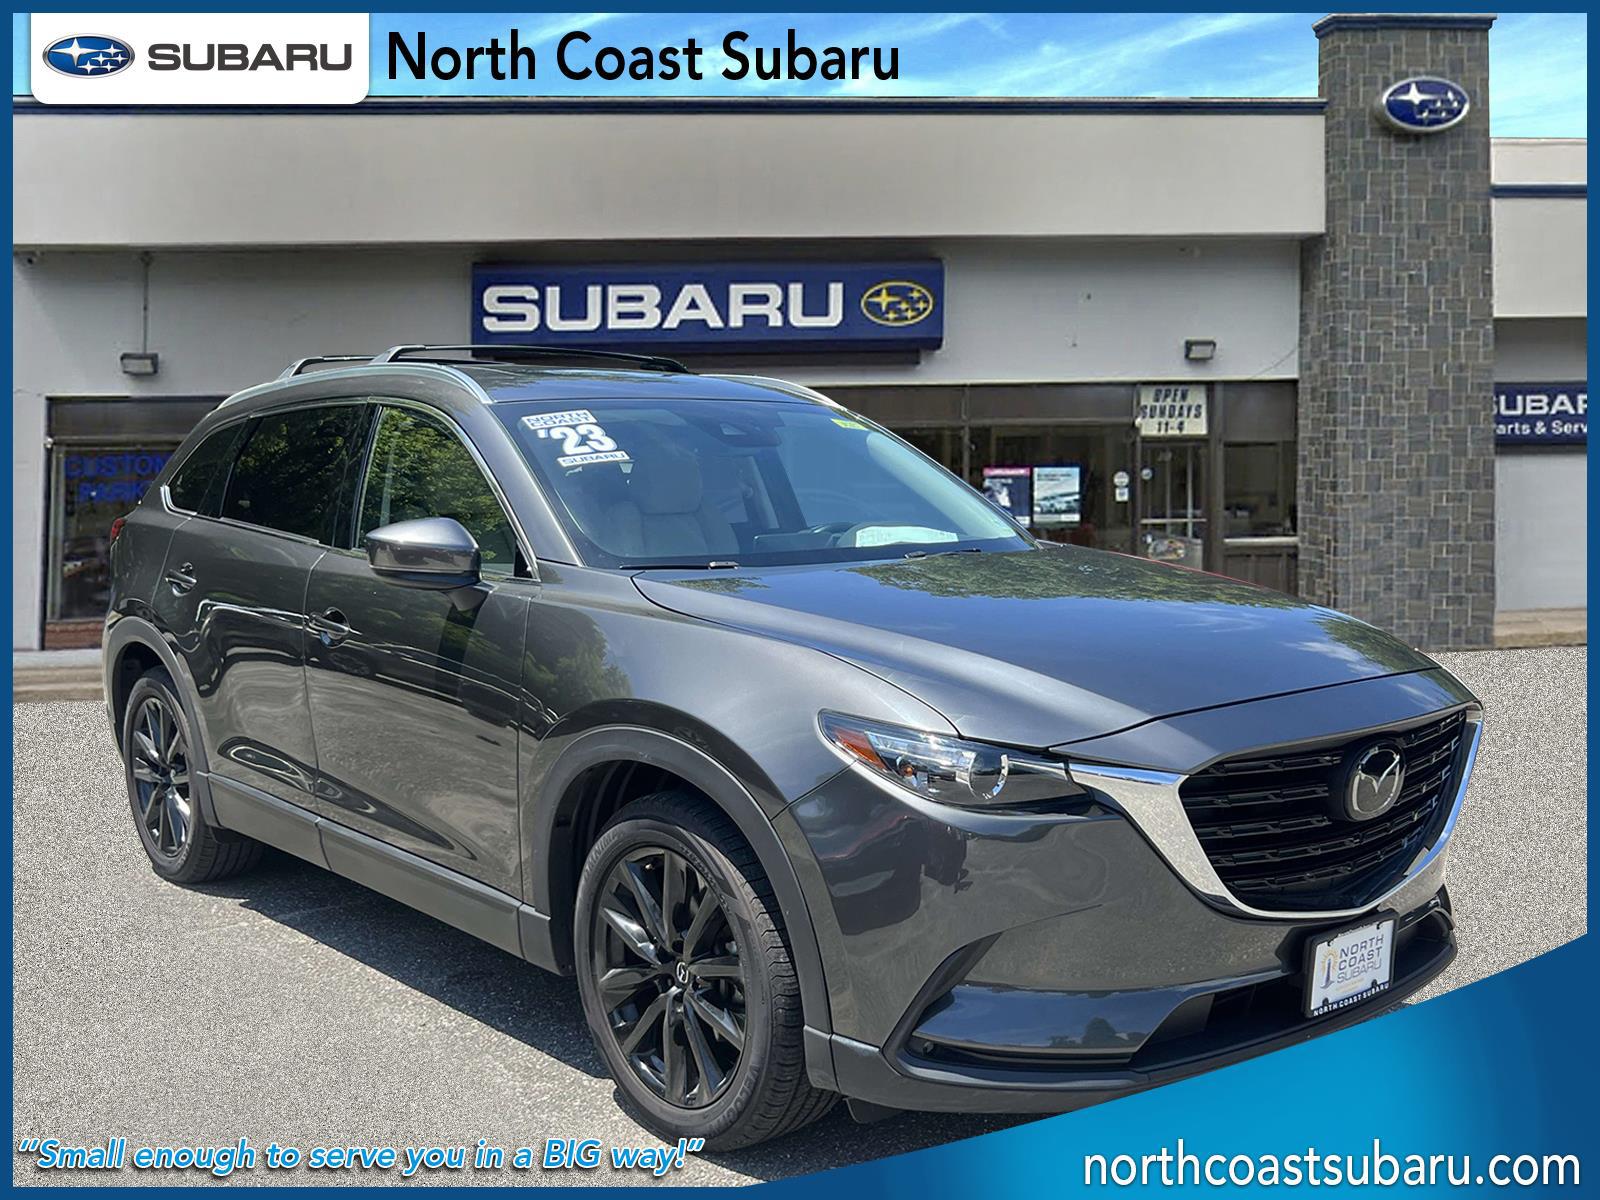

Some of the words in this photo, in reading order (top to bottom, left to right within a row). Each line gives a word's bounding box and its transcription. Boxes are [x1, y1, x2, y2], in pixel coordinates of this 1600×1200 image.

[482, 282, 844, 333] SUBARU
[1153, 388, 1189, 403] OPEN
[1493, 394, 1587, 415] UBA
[526, 410, 589, 423] NORTH
[531, 416, 593, 428] COAST
[1141, 404, 1203, 419] SUNDAYS
[1534, 420, 1547, 435] &
[536, 424, 618, 455] '23
[562, 452, 626, 464] SUBARU
[1340, 934, 1384, 958] NORTH
[1338, 946, 1383, 971] COAST
[1336, 958, 1383, 984] SUBARU
[1313, 1002, 1338, 1016] NORTH
[1339, 994, 1362, 1007] COAST
[1362, 983, 1389, 998] SUBARU
